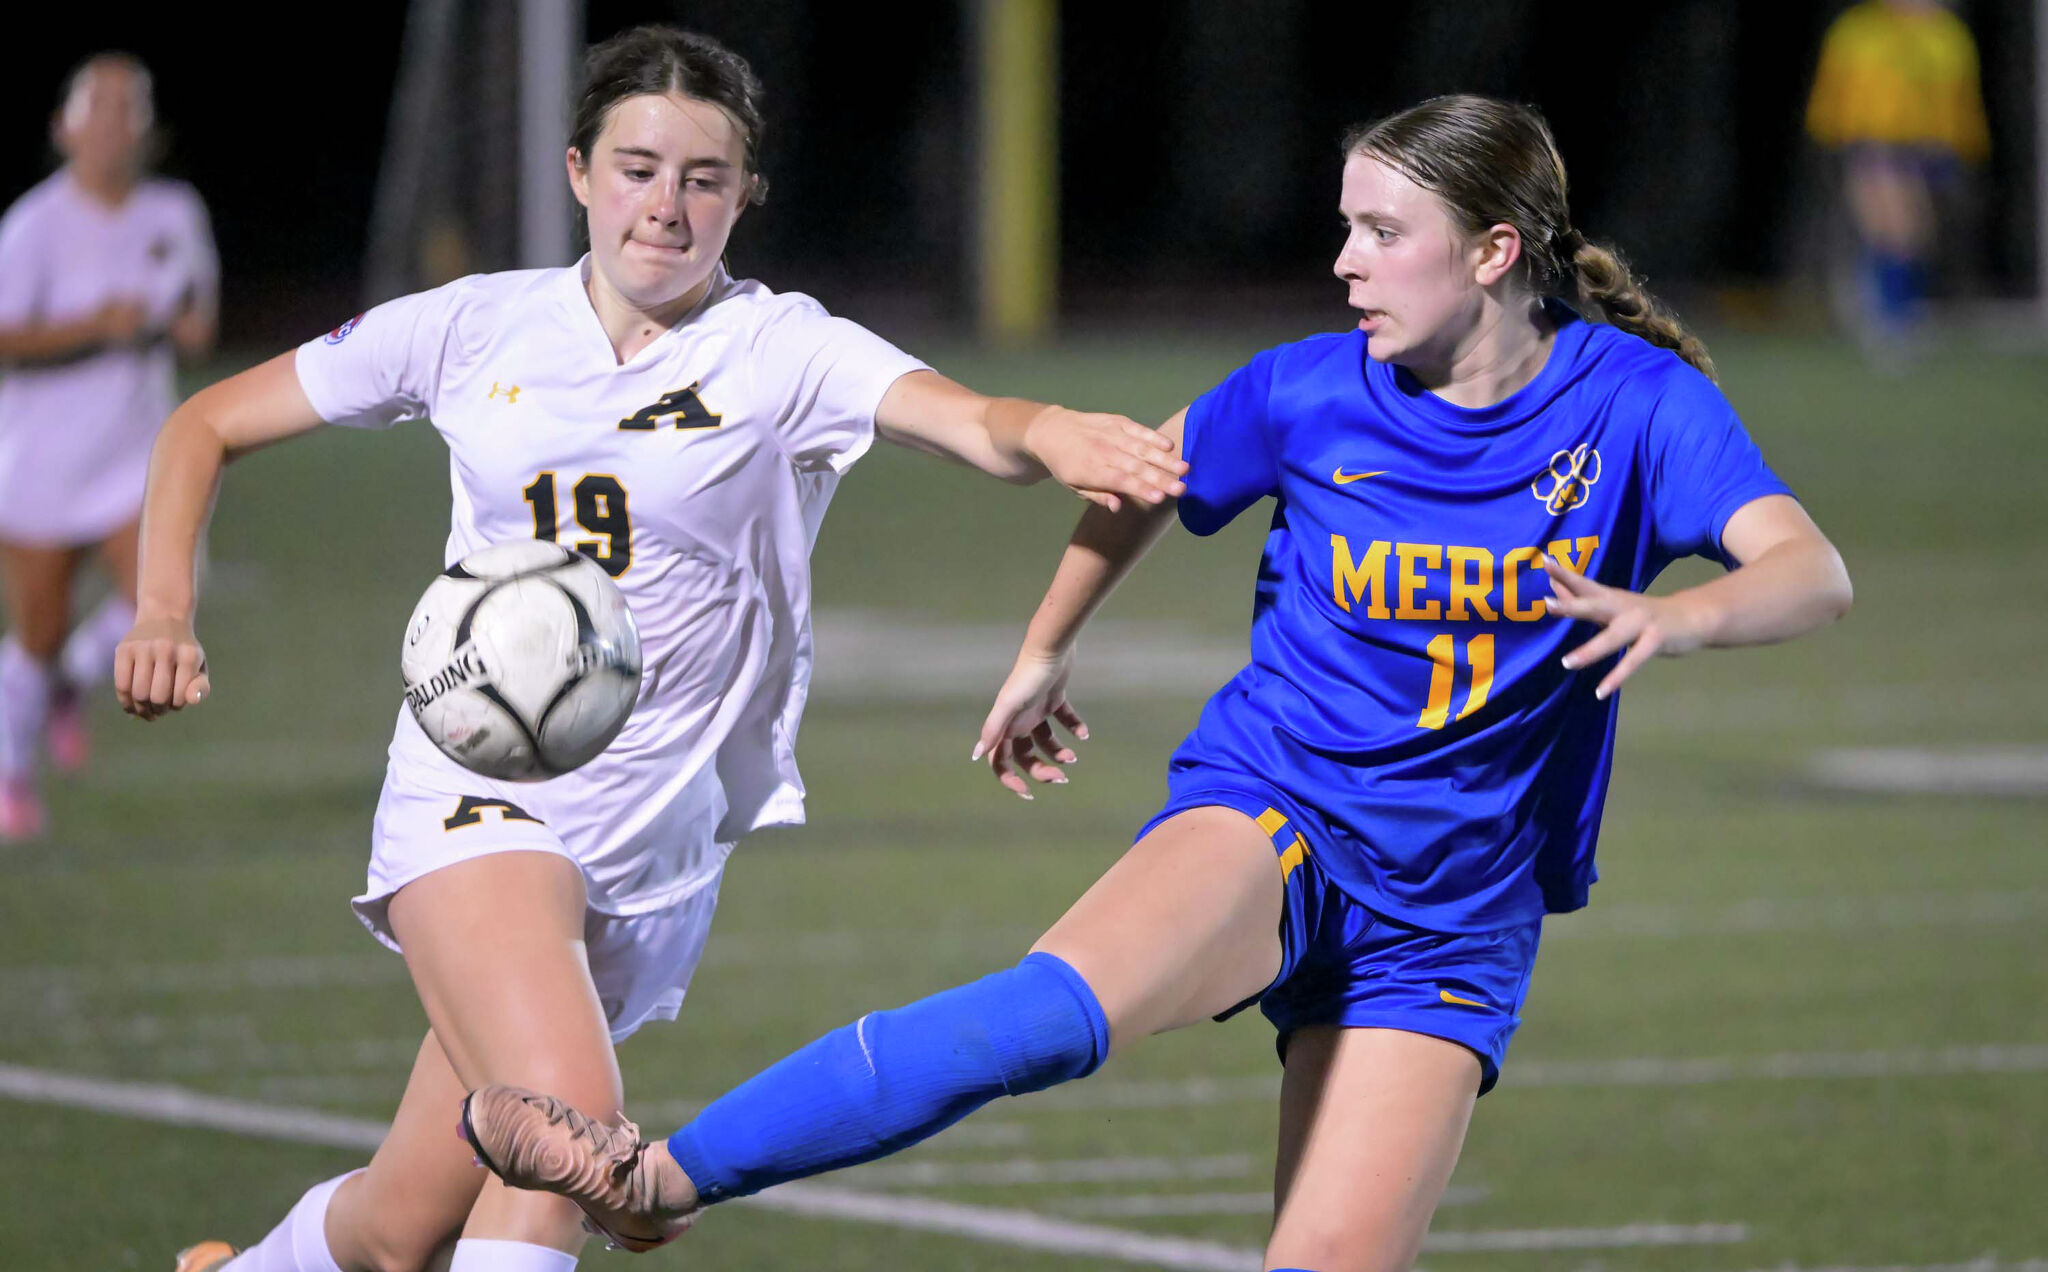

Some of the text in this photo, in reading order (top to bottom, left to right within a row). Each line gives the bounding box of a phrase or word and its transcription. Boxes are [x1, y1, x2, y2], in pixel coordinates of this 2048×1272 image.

[617, 381, 722, 431] A
[522, 471, 633, 579] 19
[405, 643, 487, 718] PALDING
[1416, 634, 1495, 730] 11
